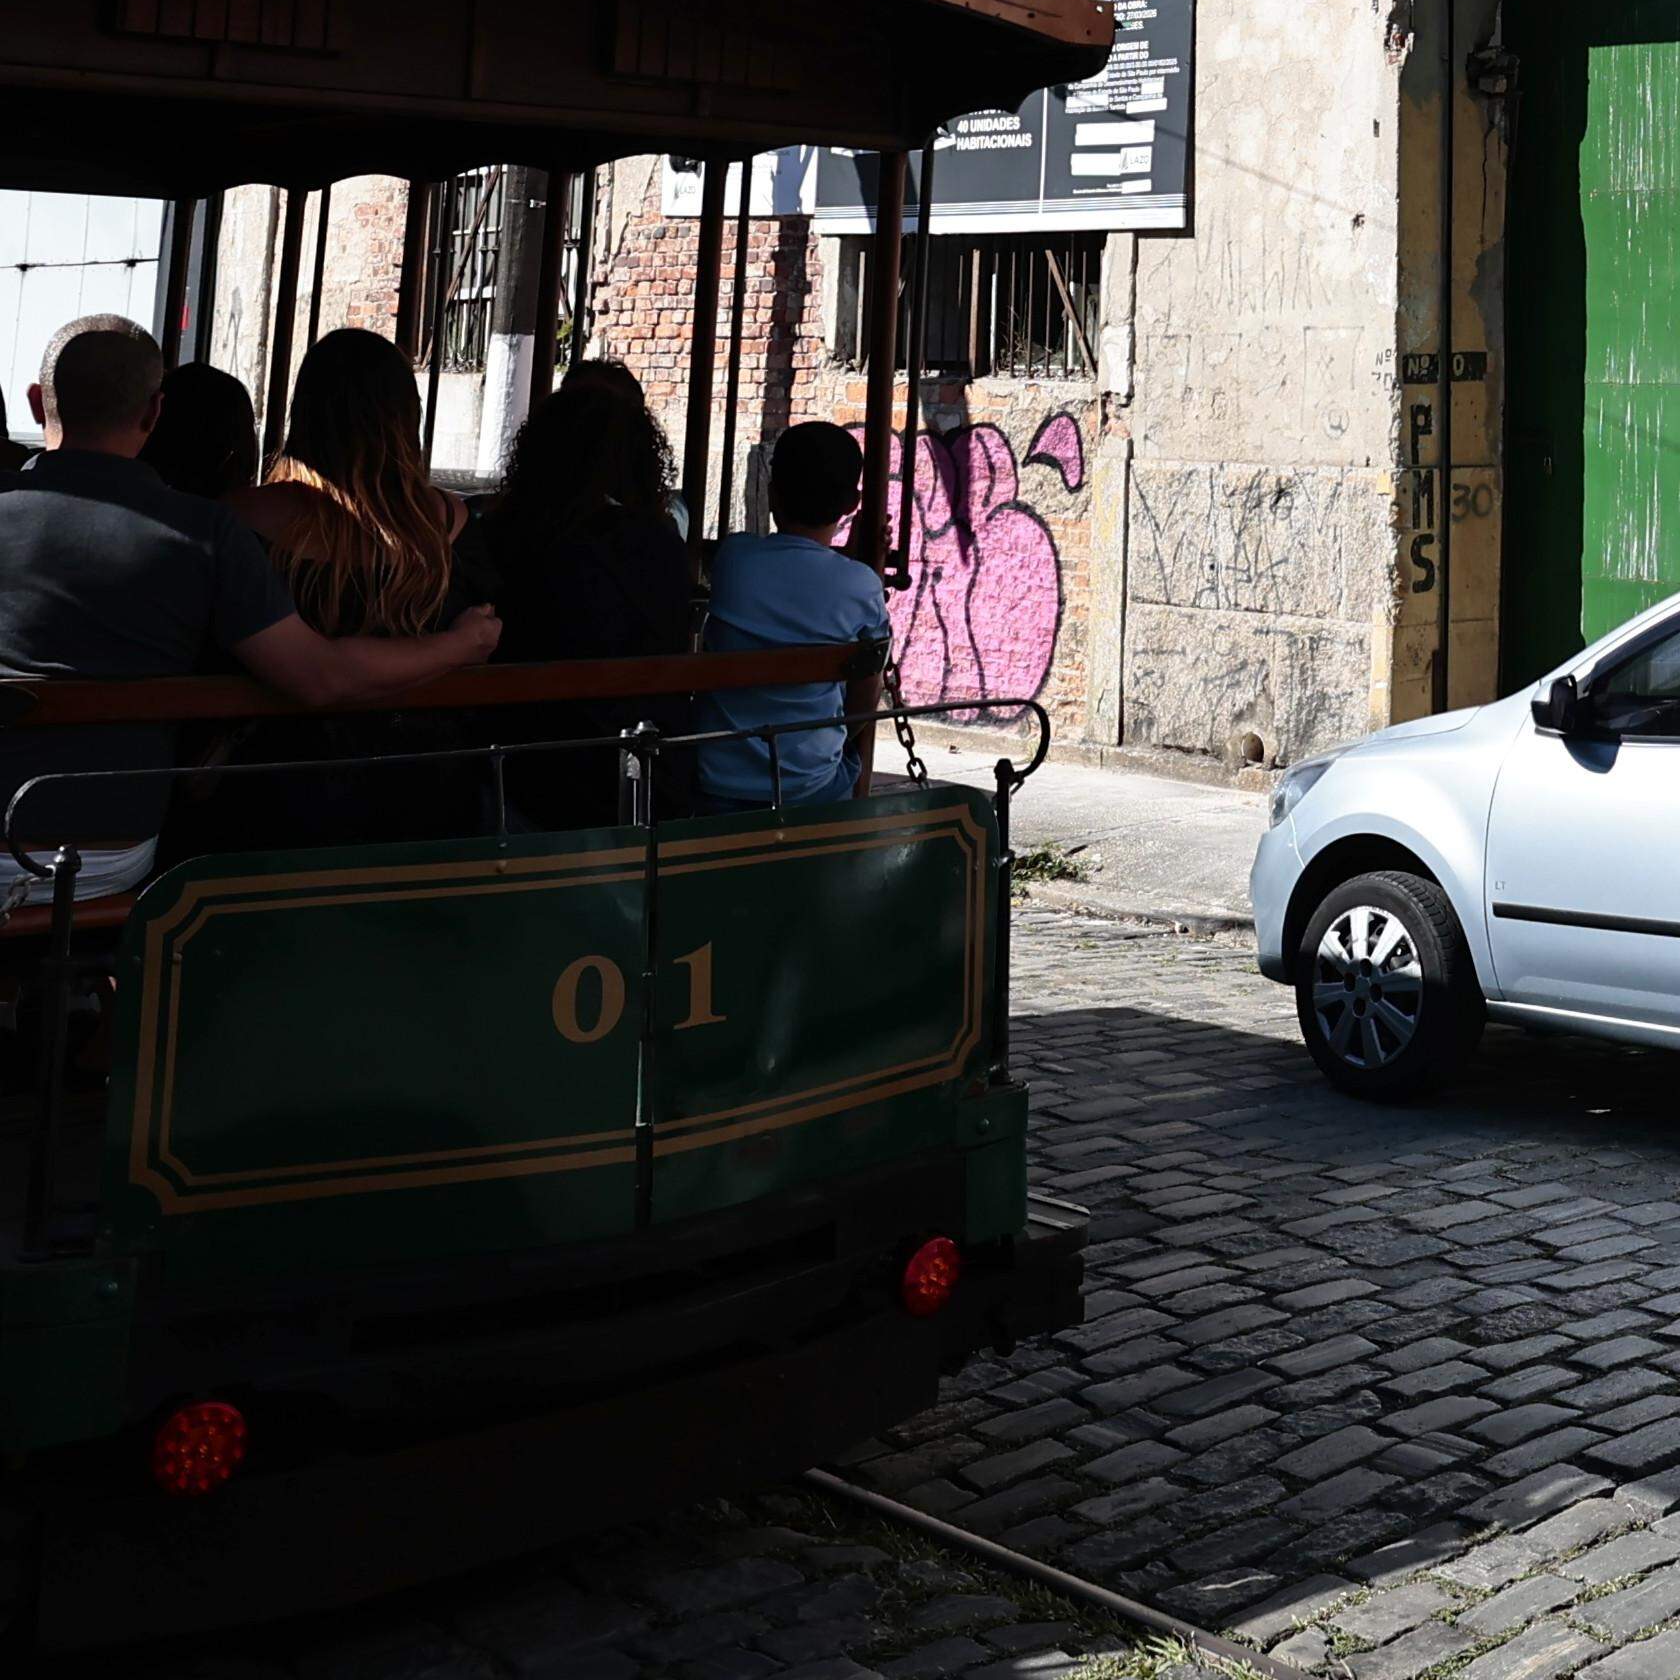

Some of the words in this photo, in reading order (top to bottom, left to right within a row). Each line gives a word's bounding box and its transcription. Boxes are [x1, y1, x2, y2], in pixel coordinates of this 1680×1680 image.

[957, 120, 969, 134] 40
[970, 116, 1020, 133] UNIDADES
[956, 133, 1032, 151] HABITACIONAIS
[1451, 483, 1494, 523] 30
